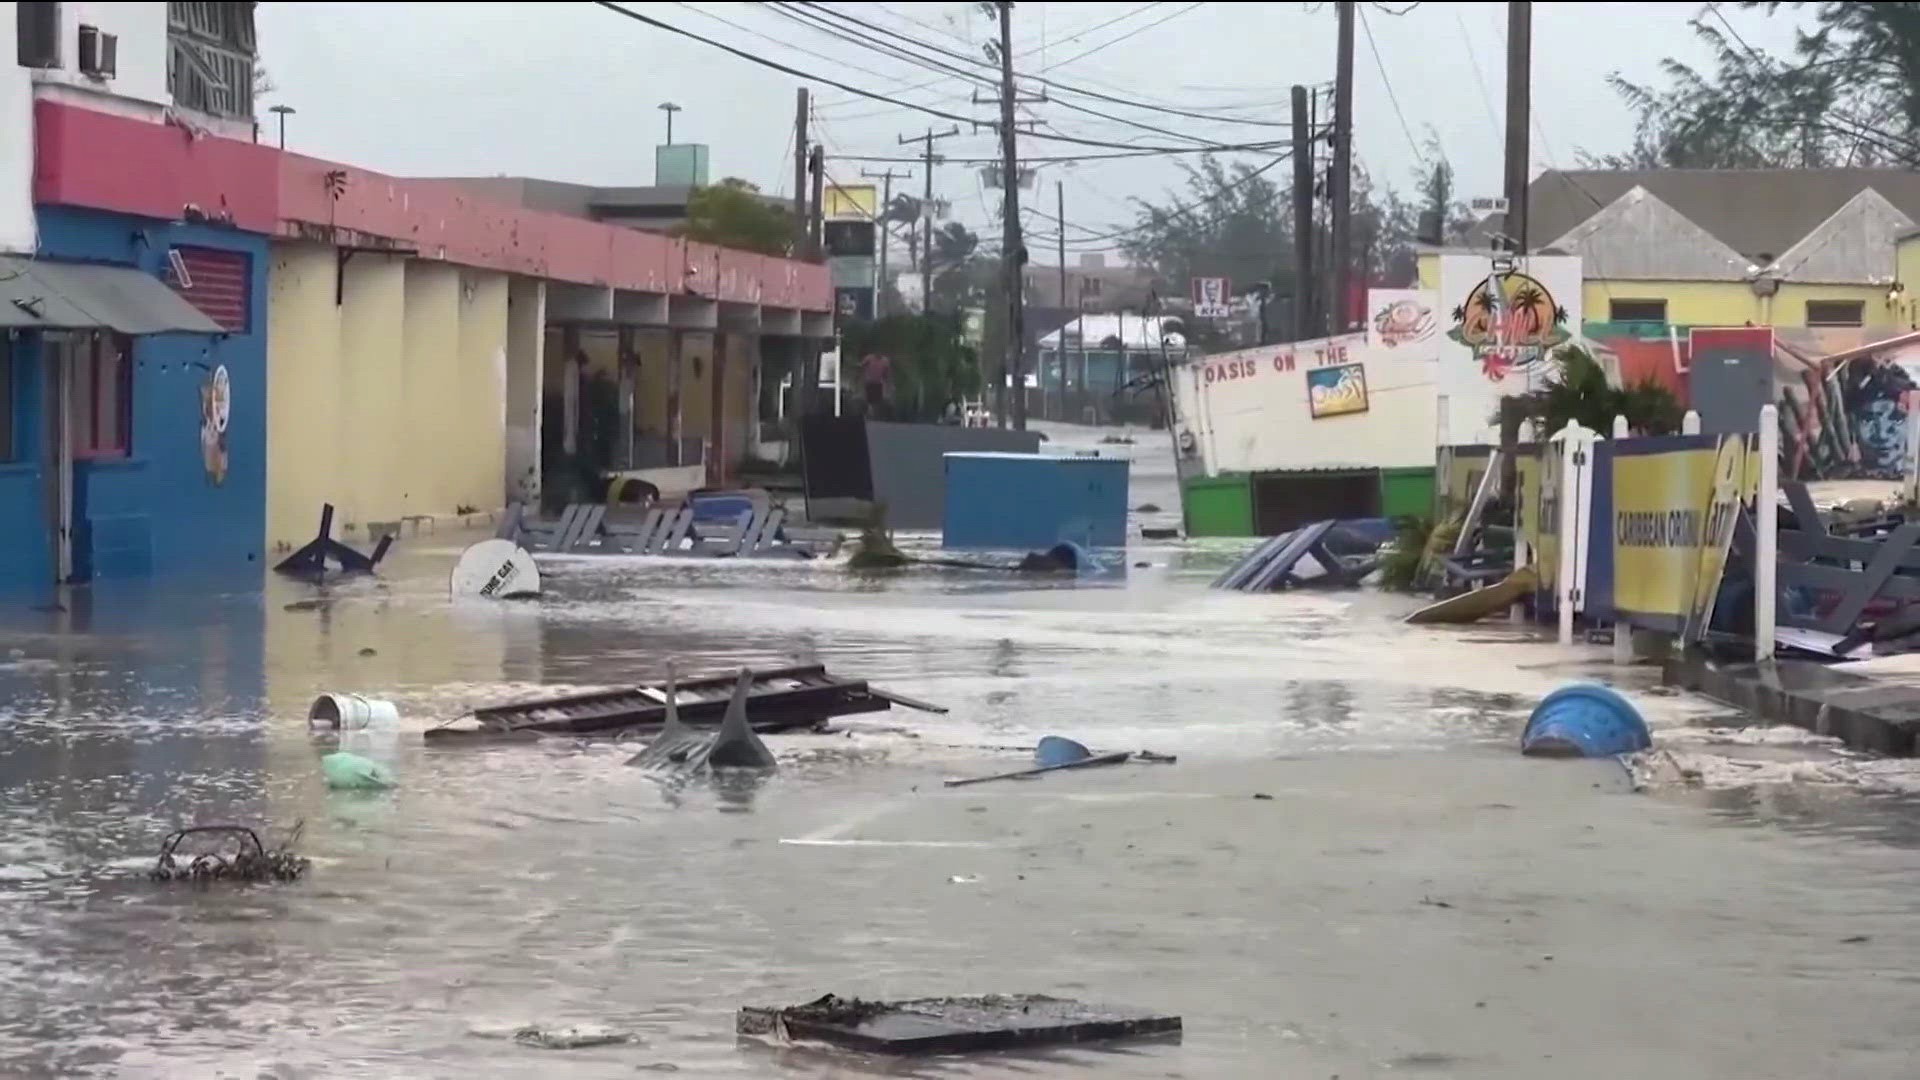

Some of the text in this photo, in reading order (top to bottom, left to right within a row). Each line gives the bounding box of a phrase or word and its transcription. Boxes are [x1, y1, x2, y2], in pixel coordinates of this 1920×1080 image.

[1205, 347, 1348, 383] OASIS ON THE
[1617, 510, 1667, 548] CARIBBEAN
